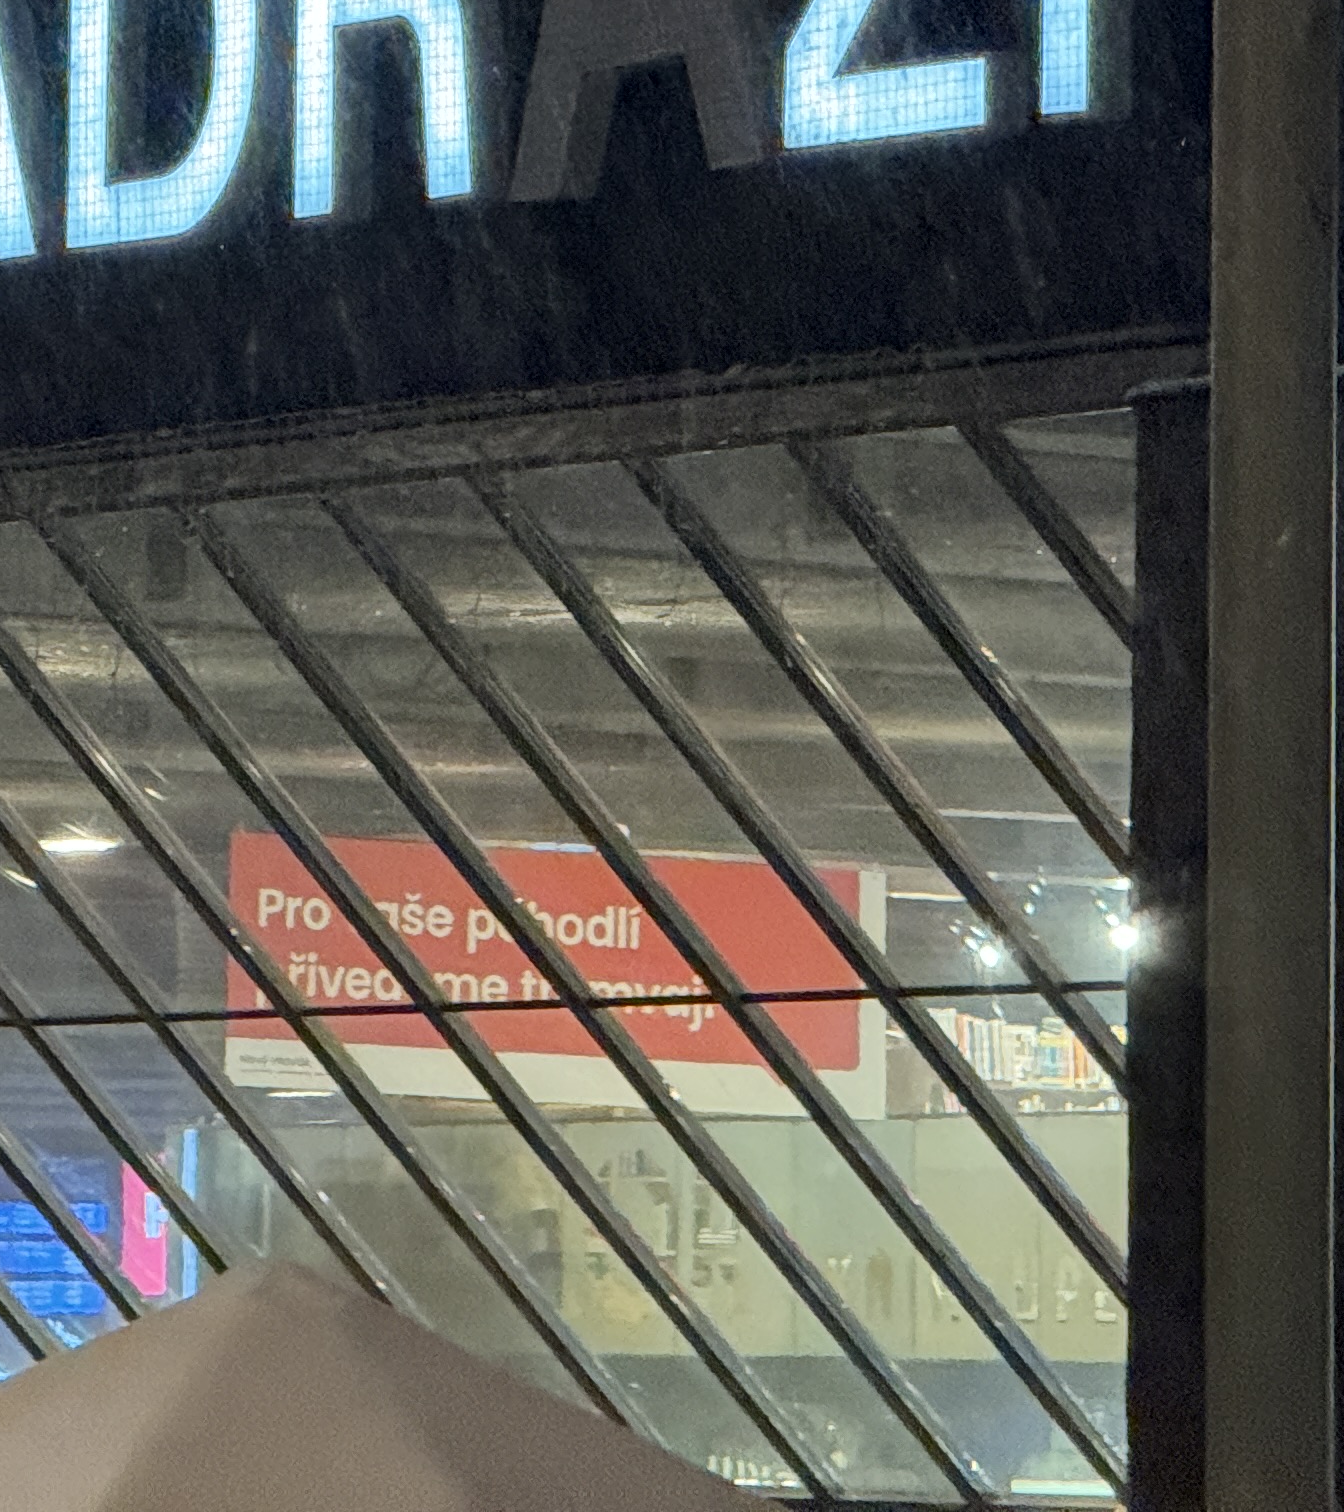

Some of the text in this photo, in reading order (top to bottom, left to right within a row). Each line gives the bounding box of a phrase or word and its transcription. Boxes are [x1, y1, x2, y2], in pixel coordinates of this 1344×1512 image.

[257, 888, 331, 931] Pro
[373, 892, 455, 938] aše
[256, 951, 715, 1032] řivedme trmvaj
